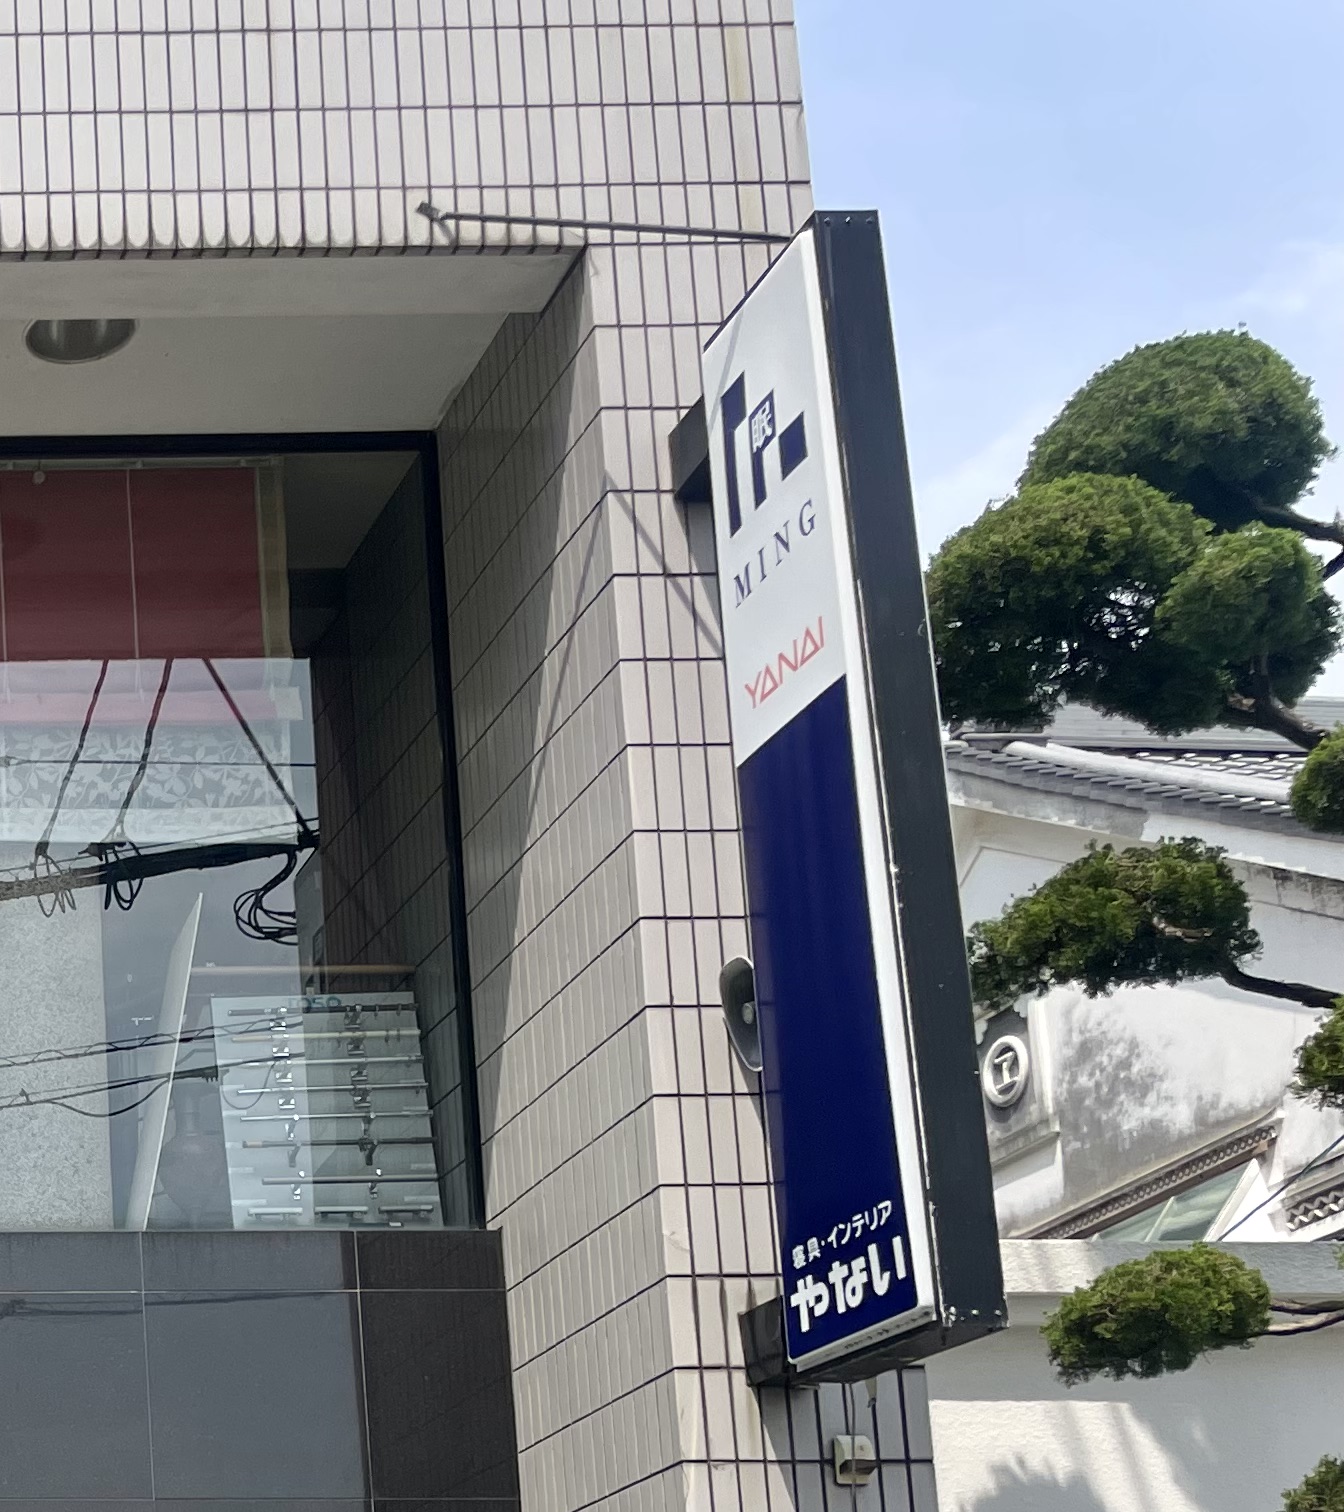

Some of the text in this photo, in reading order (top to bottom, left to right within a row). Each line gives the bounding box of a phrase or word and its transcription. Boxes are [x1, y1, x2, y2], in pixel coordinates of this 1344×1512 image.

[732, 498, 817, 608] MING
[745, 616, 825, 709] YANAI
[790, 1235, 907, 1332] やない
